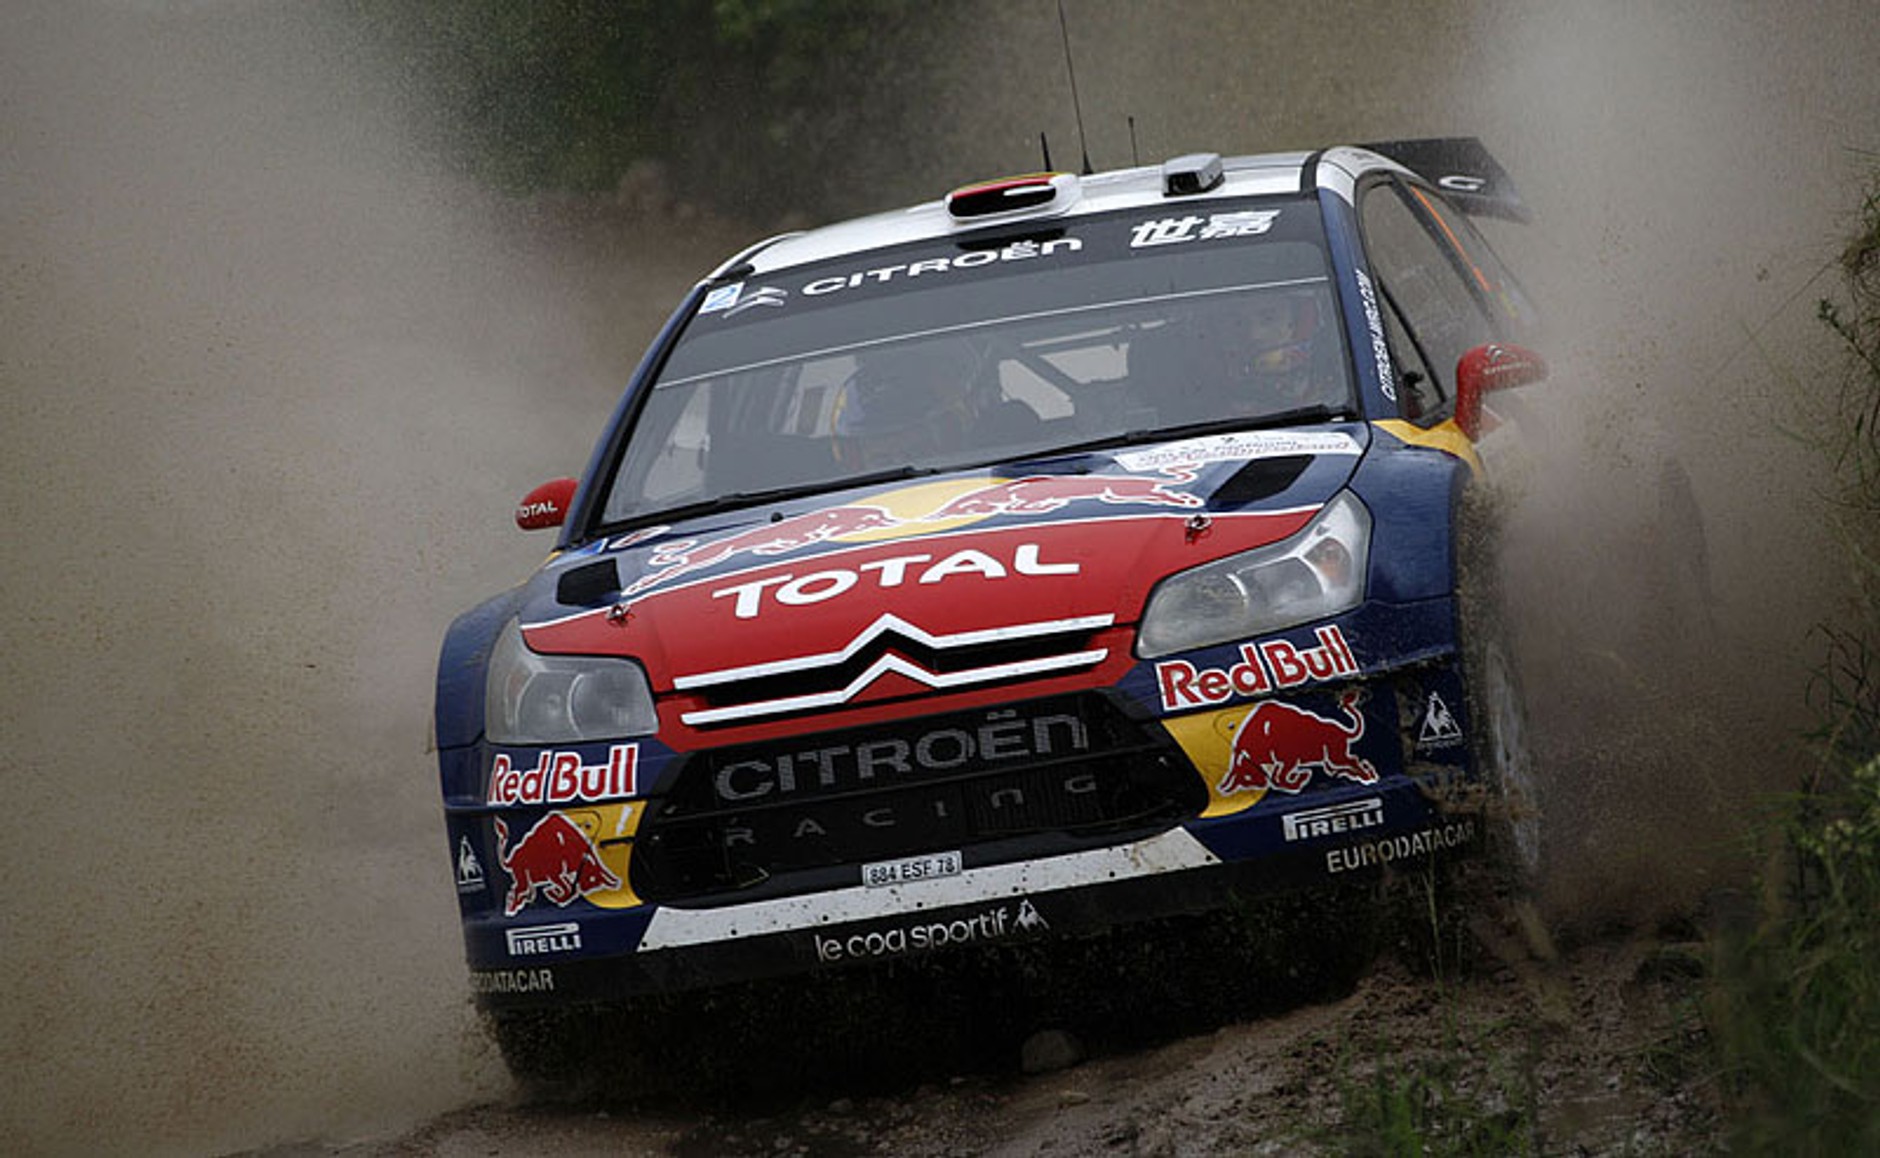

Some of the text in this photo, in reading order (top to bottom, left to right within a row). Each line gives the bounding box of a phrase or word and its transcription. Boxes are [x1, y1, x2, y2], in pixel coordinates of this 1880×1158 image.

[802, 238, 1083, 296] CITROËN
[517, 500, 559, 519] OTAL
[712, 544, 1080, 618] TOTAL
[1155, 624, 1359, 711] Red Bull
[487, 742, 639, 807] Red Bull
[715, 710, 1089, 801] CITROËN
[724, 775, 1097, 848] RACING
[1281, 797, 1384, 842] PIRELLI
[902, 860, 932, 879] ESF
[938, 857, 956, 874] 78
[505, 922, 582, 955] PIRELLI
[814, 934, 843, 962] le
[910, 906, 1010, 950] sportif
